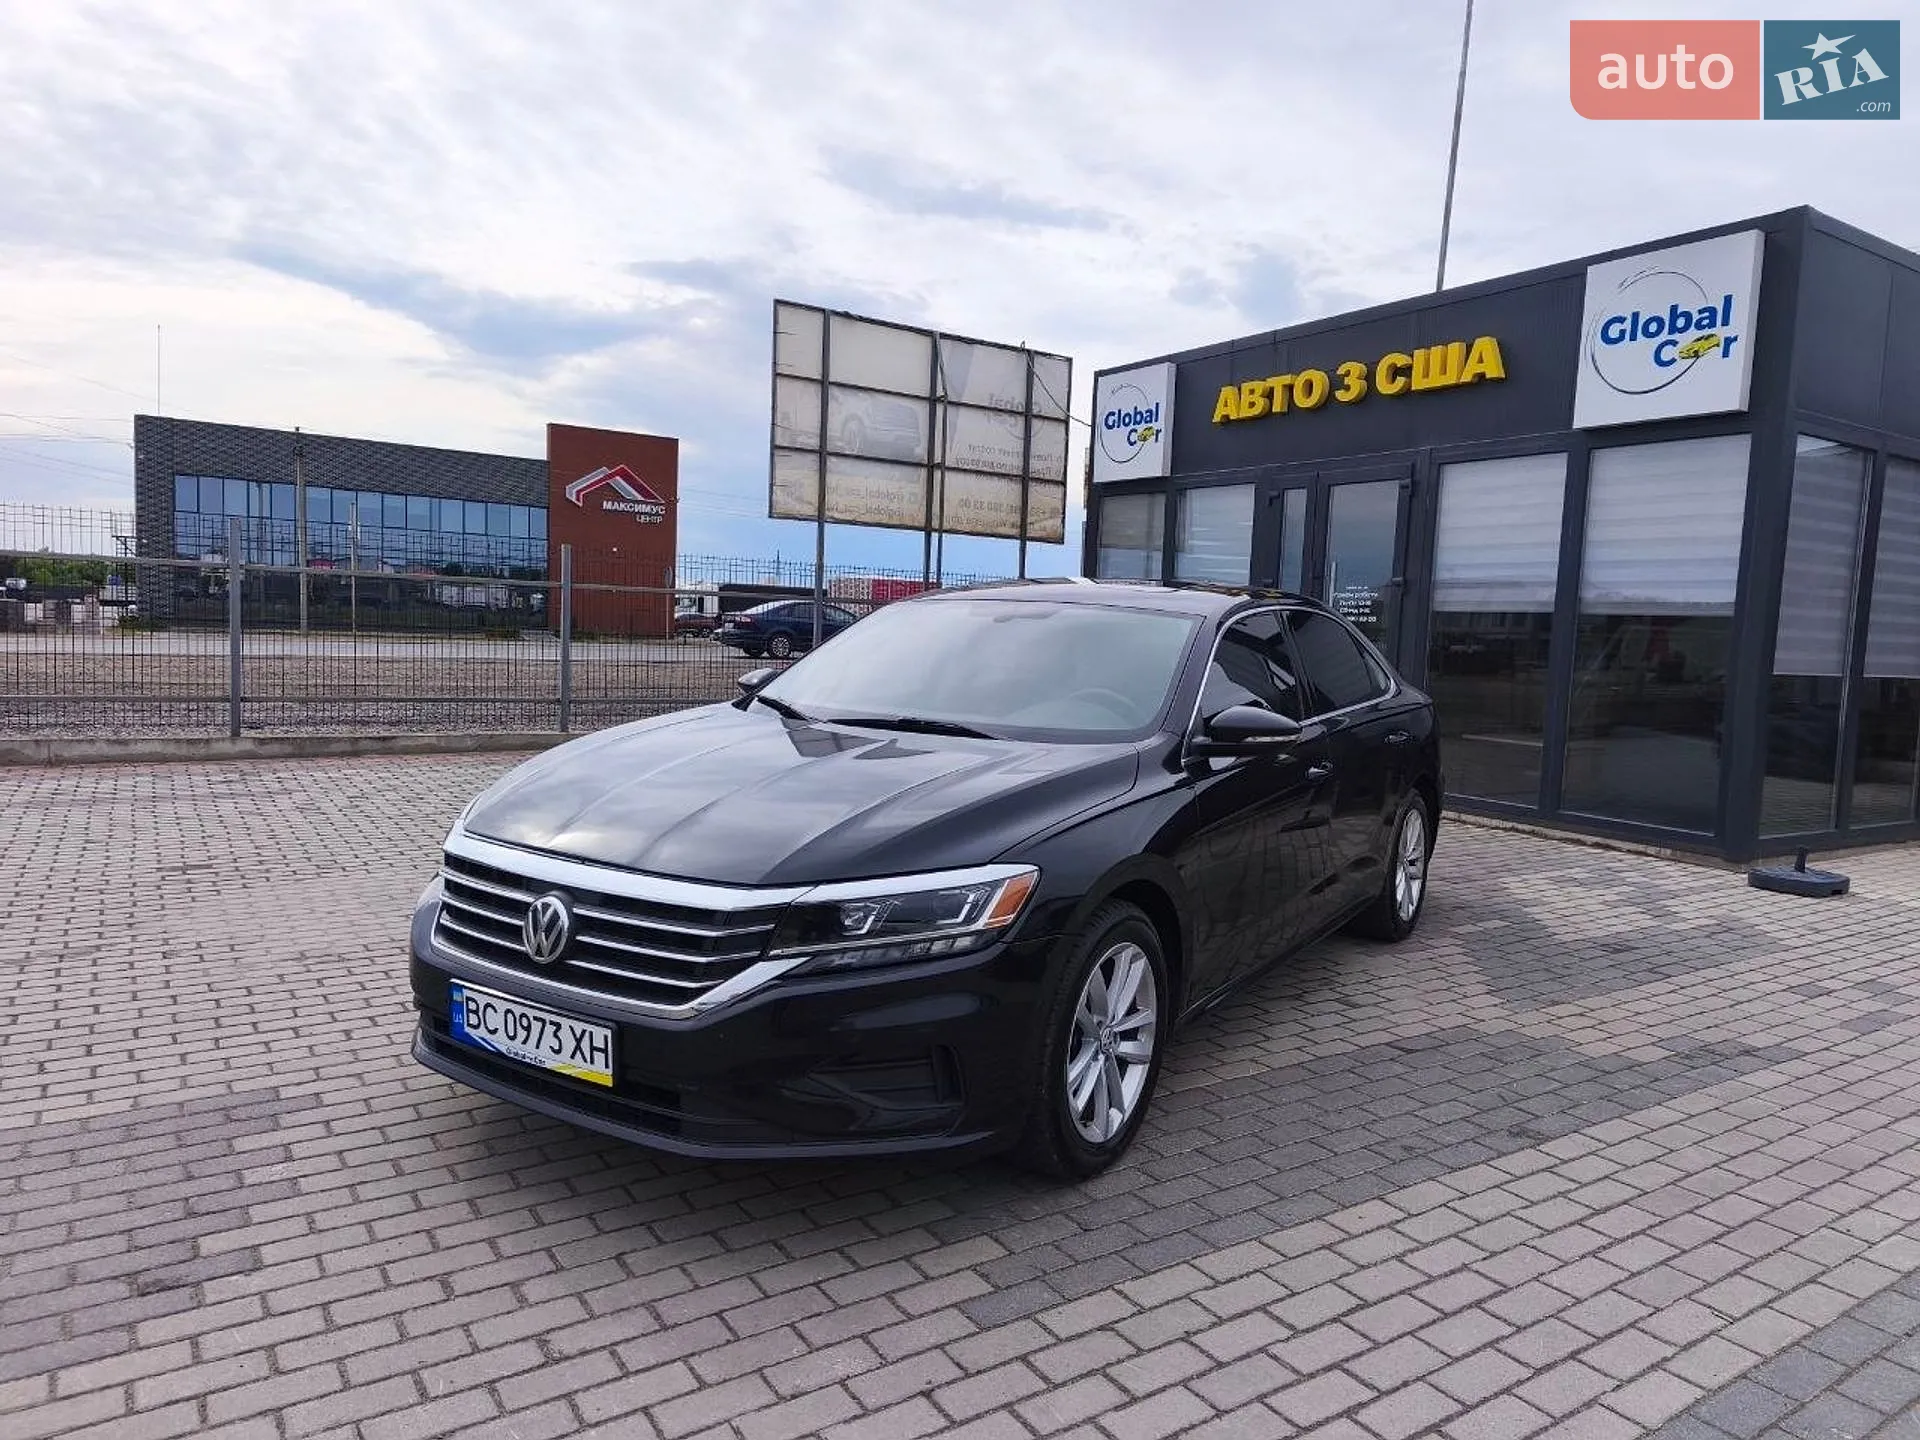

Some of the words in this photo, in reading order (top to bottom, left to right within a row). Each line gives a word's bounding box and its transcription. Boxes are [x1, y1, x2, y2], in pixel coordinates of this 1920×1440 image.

[1600, 294, 1733, 345] Global
[1212, 368, 1329, 423] АВТО
[1375, 336, 1506, 395] США
[1104, 402, 1160, 430] Global
[602, 500, 666, 514] МАКСИМУС
[636, 514, 663, 524] ЦЕНТР
[465, 996, 499, 1036] BC
[504, 1008, 563, 1055] 0973
[569, 1025, 610, 1069] XH
